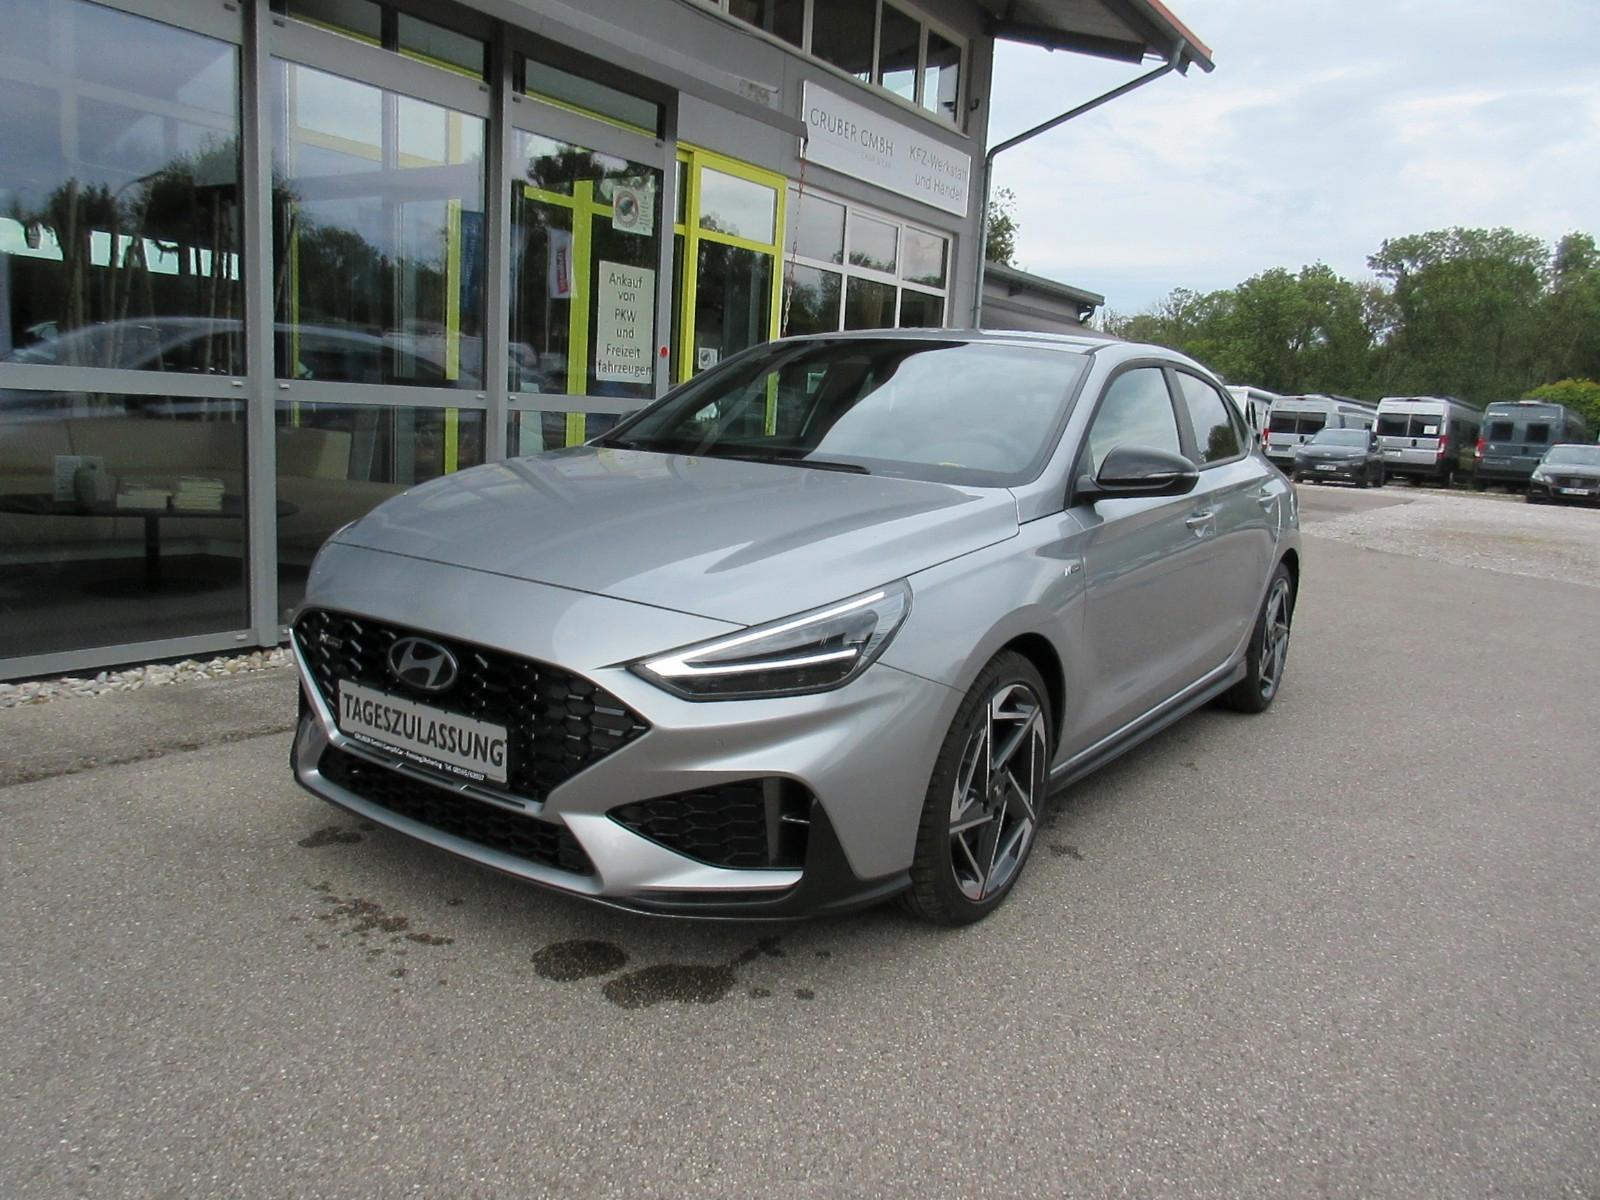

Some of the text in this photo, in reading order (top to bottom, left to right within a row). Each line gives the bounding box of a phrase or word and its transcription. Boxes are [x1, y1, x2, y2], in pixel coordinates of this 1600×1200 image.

[811, 108, 894, 157] GRUBER GMBH
[915, 175, 963, 201] und Handel
[609, 272, 643, 288] Ankauf
[618, 290, 635, 302] von
[614, 308, 636, 322] PKW
[616, 327, 634, 339] und
[606, 343, 640, 358] Freizeit
[598, 360, 652, 378] fahrzeugen
[343, 693, 504, 767] TAGESZULASSUNG
